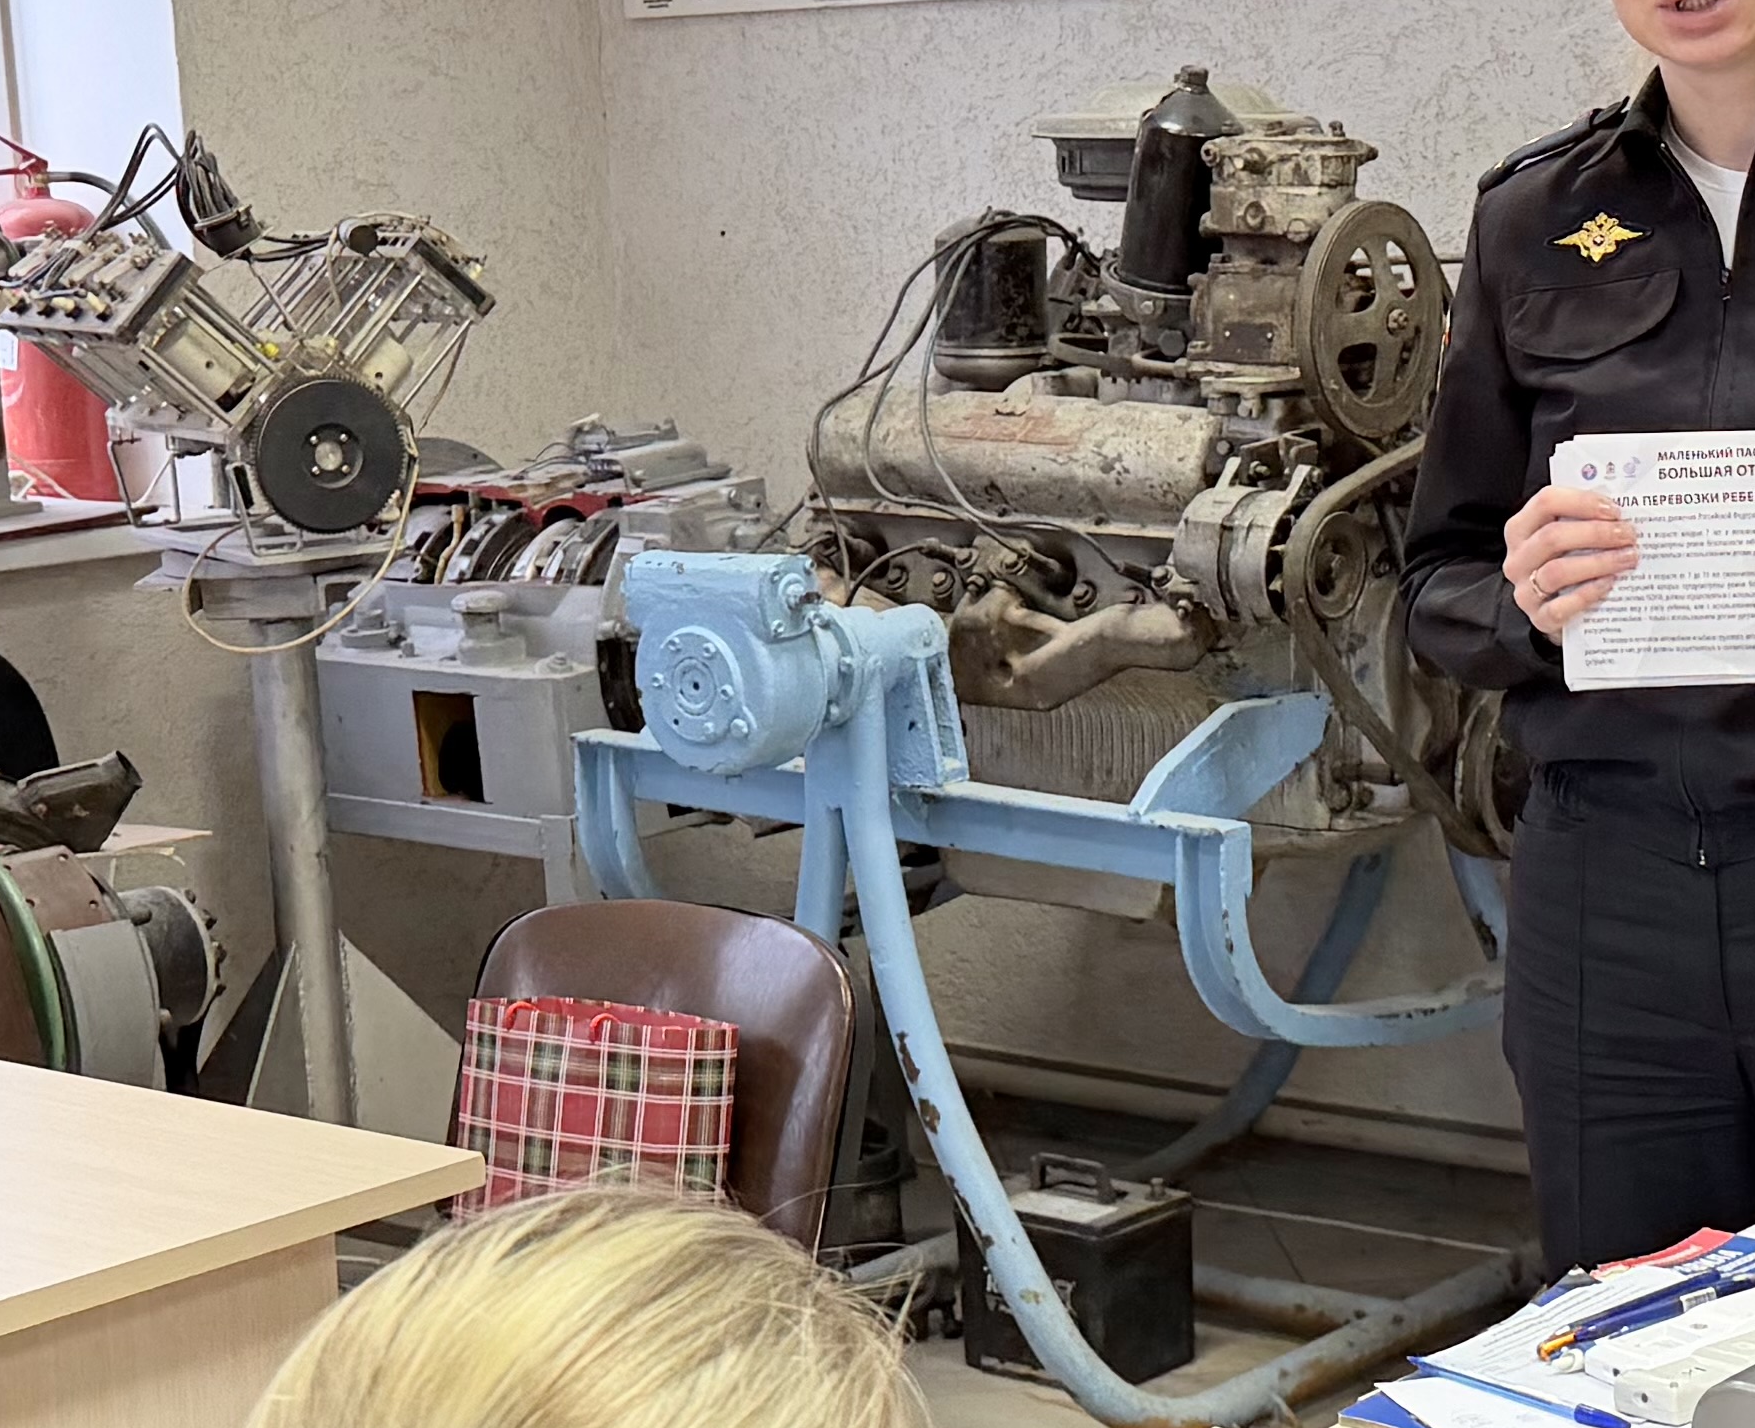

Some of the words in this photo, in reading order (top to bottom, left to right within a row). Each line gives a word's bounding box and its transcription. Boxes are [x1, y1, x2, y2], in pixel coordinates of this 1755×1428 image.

[1657, 447, 1733, 462] МАЛЕНЬКИЙ
[1658, 465, 1733, 480] БОЛЬШАЯ
[1643, 492, 1719, 506] ПЕРЕВОЗКИ
